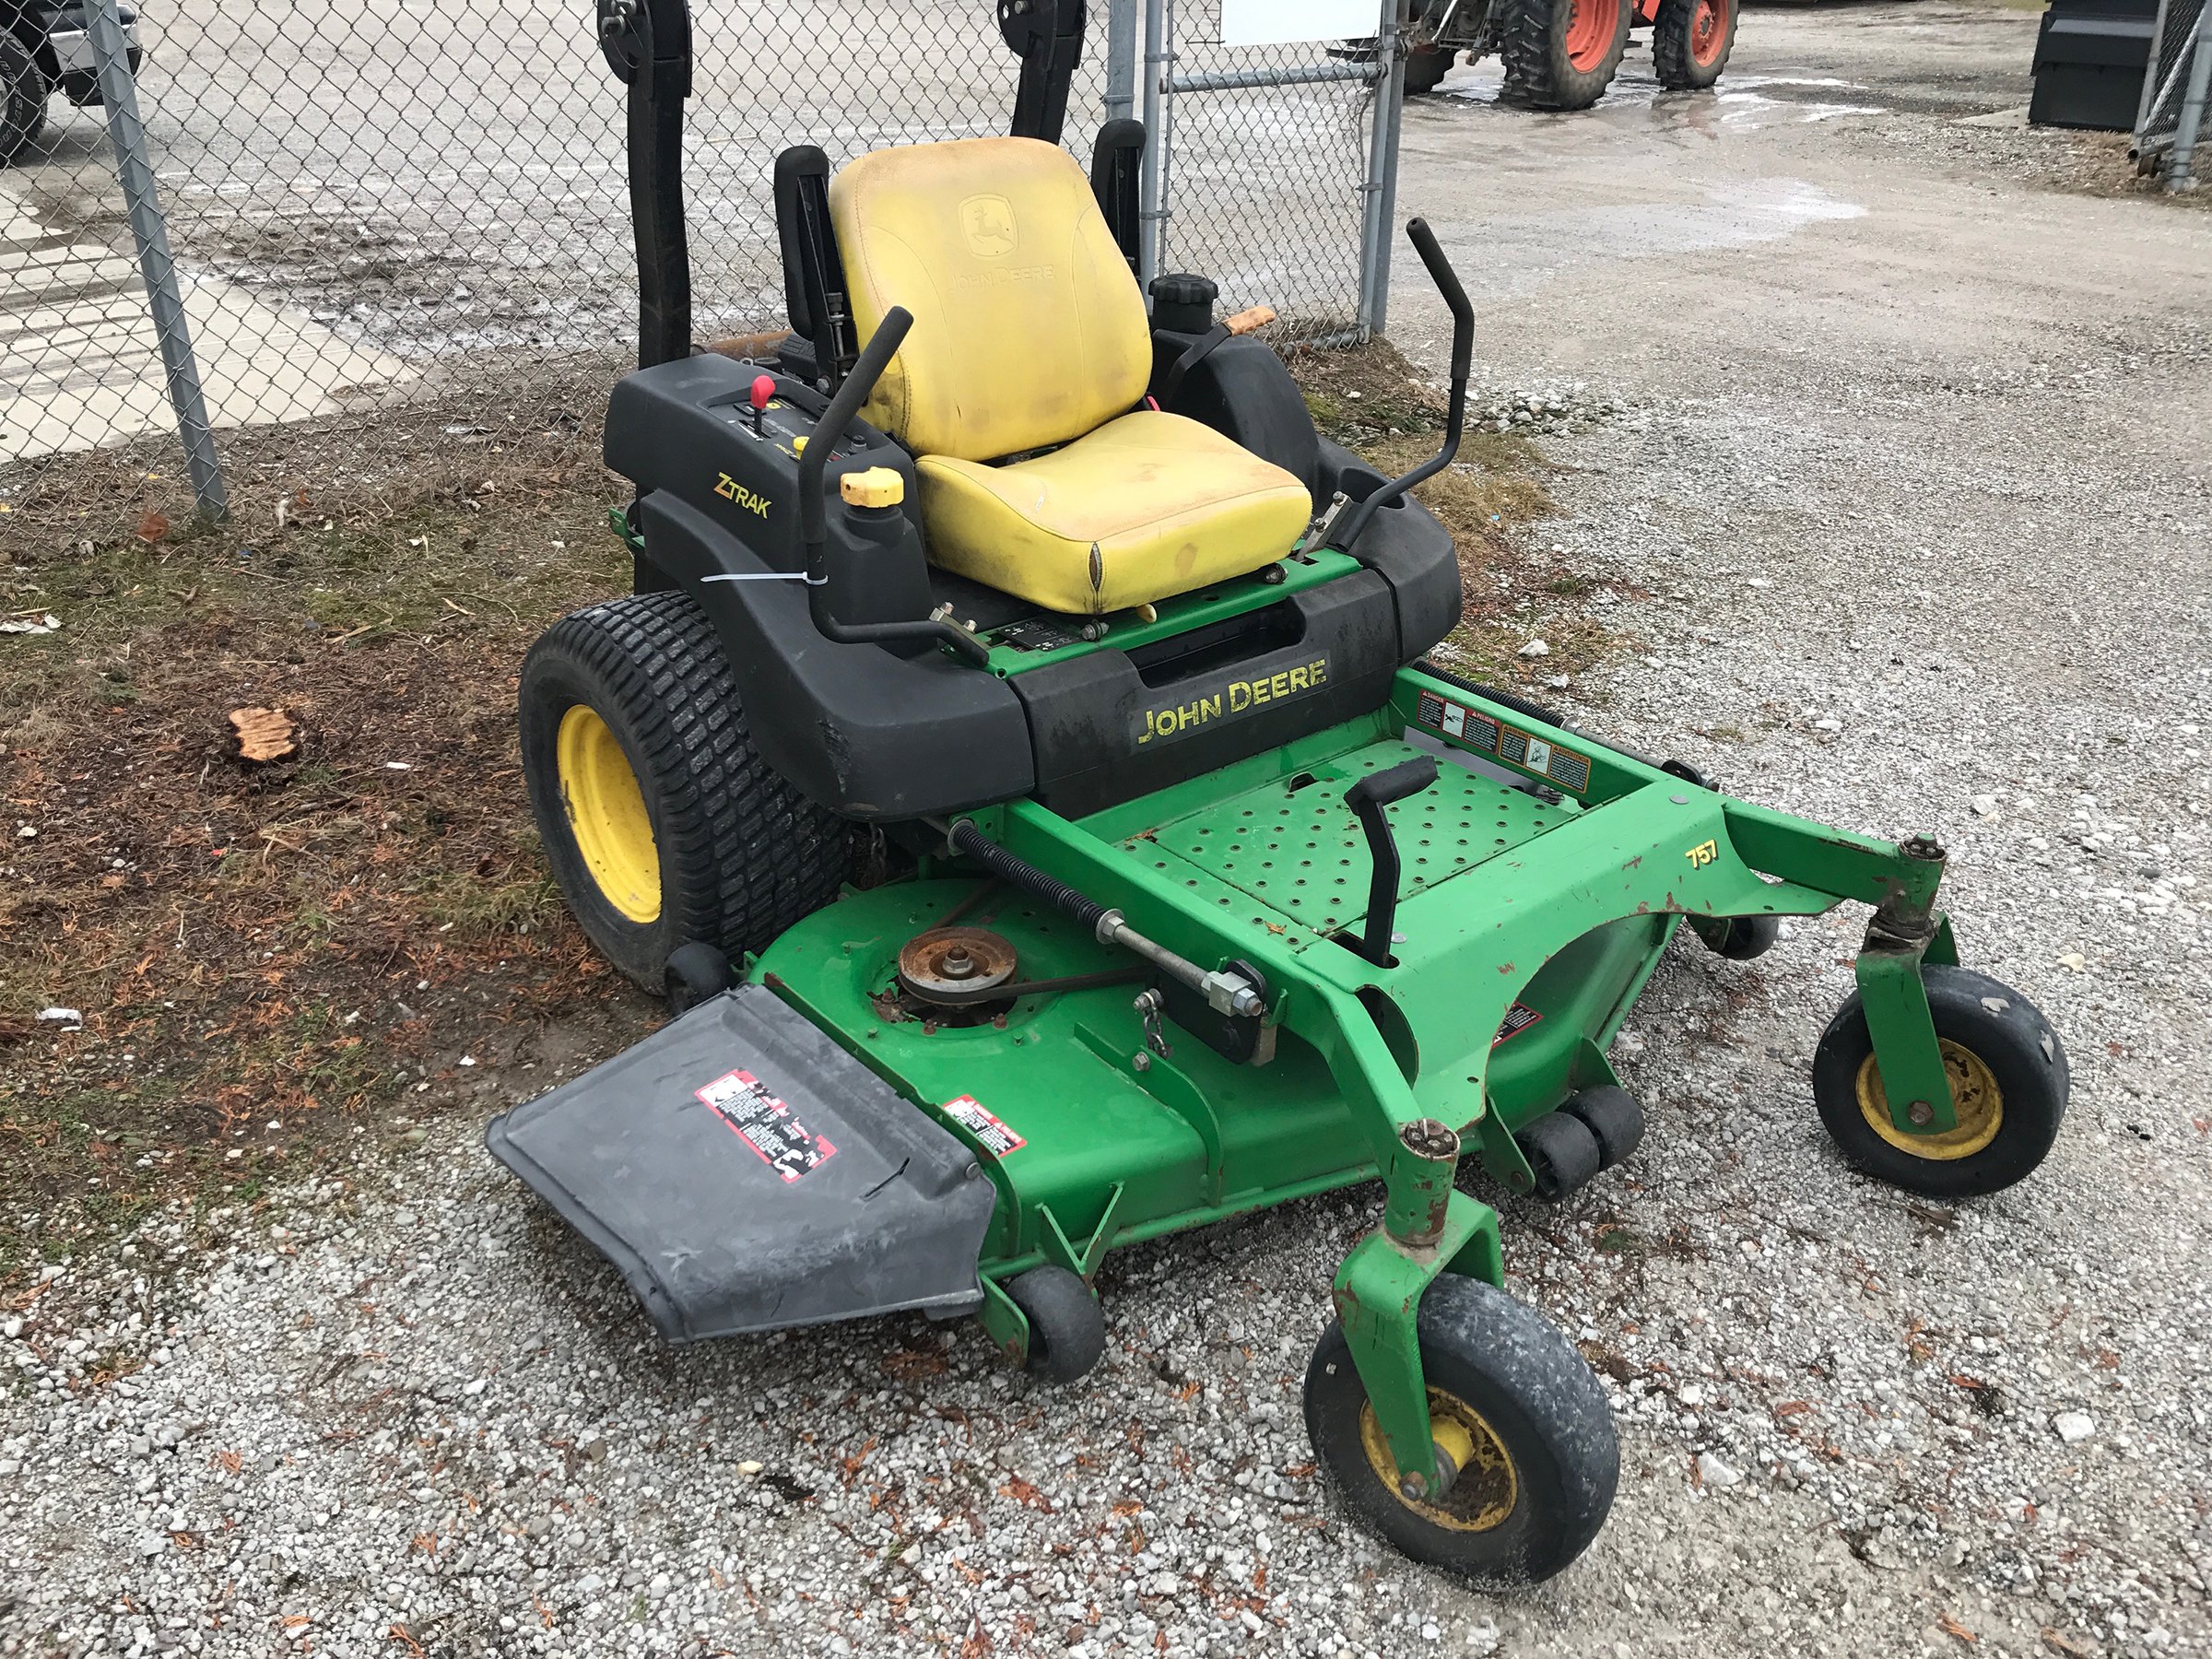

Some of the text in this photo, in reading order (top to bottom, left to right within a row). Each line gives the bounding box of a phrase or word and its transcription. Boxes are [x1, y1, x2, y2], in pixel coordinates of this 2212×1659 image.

[948, 264, 1056, 292] JOHN DEERE
[713, 471, 772, 519] ZTRAK
[1137, 659, 1327, 745] JOHN DEERE
[1685, 839, 1718, 869] 757
